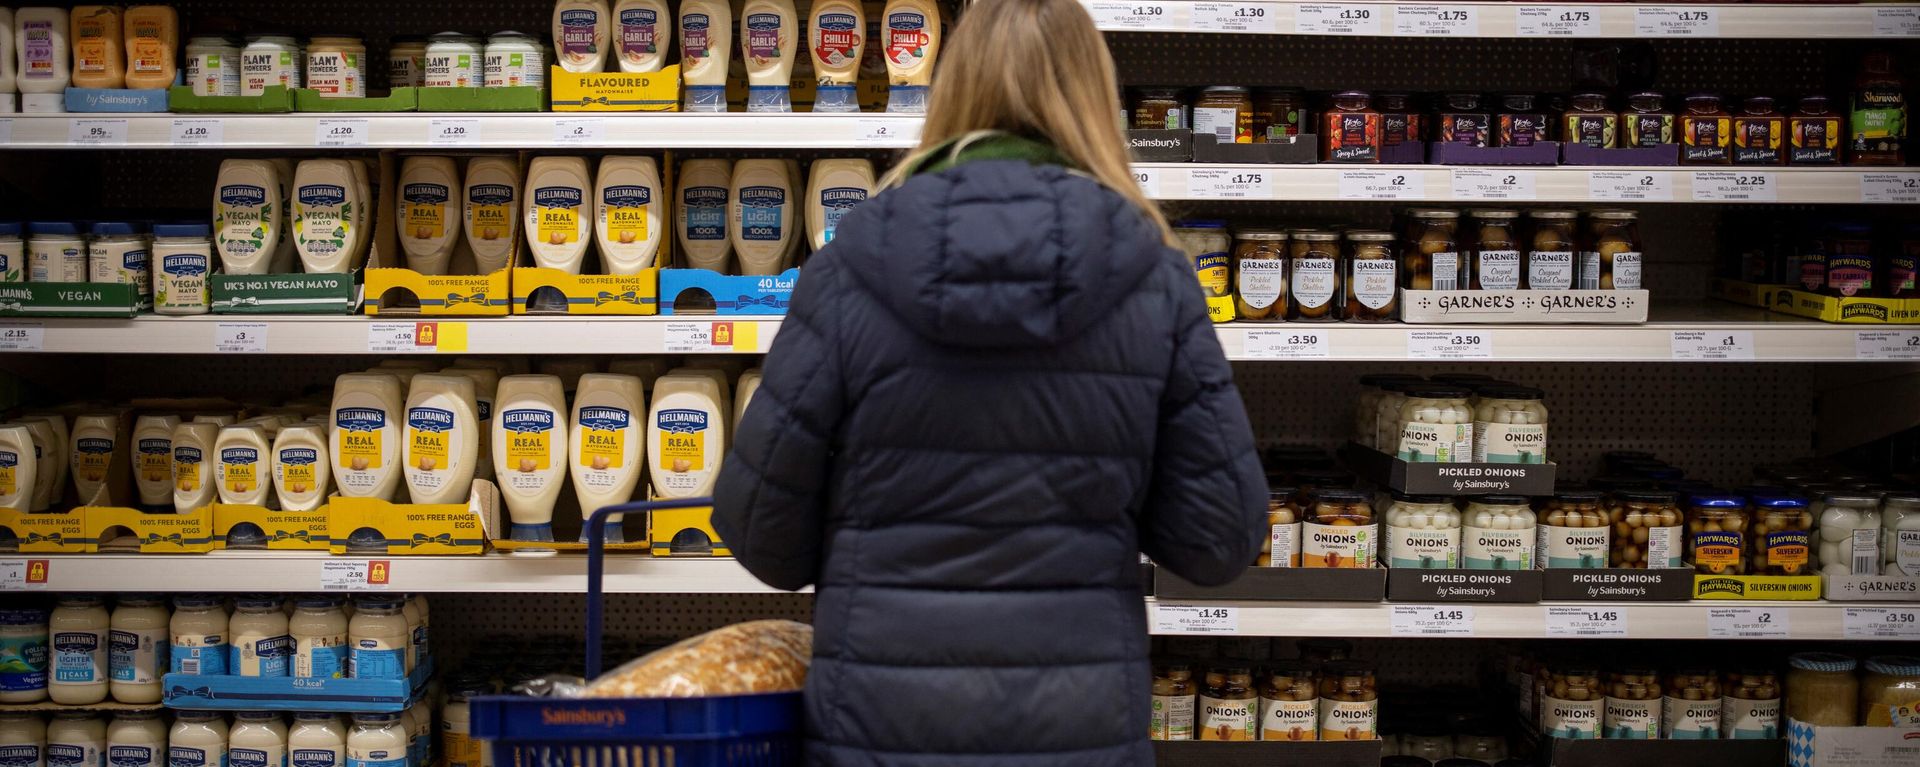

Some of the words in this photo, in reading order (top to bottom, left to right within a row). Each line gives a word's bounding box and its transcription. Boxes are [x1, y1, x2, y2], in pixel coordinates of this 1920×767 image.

[562, 11, 596, 20] HELLMANN'S
[621, 11, 655, 20] HELLMANN'S
[1133, 7, 1163, 16] £1.30
[1235, 8, 1264, 17] £1.30
[1340, 9, 1370, 19] £1.30
[1438, 11, 1468, 21] £1.75
[1560, 12, 1590, 21] £1.75
[1679, 11, 1708, 21] £1.75
[748, 16, 779, 24] HELLMANN'S
[821, 15, 854, 24] HELLMANN'S
[890, 15, 922, 24] HELLMANN'S
[565, 33, 593, 42] GARLIC
[625, 33, 652, 42] GARLIC
[751, 37, 777, 47] GARLIC
[824, 34, 850, 44] CHILLI
[893, 34, 917, 43] CHILLI
[243, 55, 272, 65] PLANT
[310, 56, 338, 66] PLANT
[580, 78, 649, 87] FLAVOURED
[86, 94, 98, 105] by
[98, 94, 148, 106] Sainsbury's
[90, 127, 106, 136] 95p
[185, 127, 206, 135] £1.20
[331, 127, 352, 135] £1.20
[574, 127, 583, 135] £2
[1131, 138, 1180, 148] Sainsbury's
[1336, 149, 1350, 158] Spicy
[1355, 148, 1370, 156] Sweet
[1688, 150, 1702, 159] Sweet
[1707, 148, 1723, 157] Spiced
[1232, 174, 1261, 184] £1.75
[1392, 175, 1406, 185] £2
[1640, 176, 1653, 185] £2
[1736, 176, 1765, 185] £2.25
[222, 188, 263, 199] HELLMANN'S
[300, 187, 342, 199] HELLMANN'S
[406, 186, 446, 197] HELLMANN'S
[471, 187, 511, 198] HELLMANN'S
[537, 189, 579, 201] HELLMANN'S
[606, 188, 648, 199] HELLMANN'S
[742, 189, 782, 200] HELLMANN'S
[225, 211, 259, 220] VEGAN
[304, 211, 339, 220] VEGAN
[413, 208, 437, 217] REAL
[545, 213, 571, 222] REAL
[614, 212, 640, 220] REAL
[747, 212, 776, 222] LIGHT
[750, 227, 773, 235] 100%
[165, 255, 207, 268] HELLMANN'S
[1482, 253, 1519, 263] GARNER'S
[1242, 261, 1279, 271] GARNER'S
[1294, 260, 1332, 271] GARNER'S
[1357, 261, 1394, 271] GARNER'S
[1491, 268, 1513, 277] Original
[171, 280, 203, 288] VEGAN
[224, 281, 244, 290] UK'S
[247, 281, 267, 290] NO.1
[270, 280, 300, 289] VEGAN
[303, 279, 338, 288] MAYO
[758, 278, 772, 288] 40
[775, 278, 794, 288] kcal
[58, 291, 101, 301] VEGAN
[1438, 295, 1515, 314] GARNER'S
[1541, 295, 1617, 314] GARNER'S
[1844, 307, 1886, 319] HAYWARDS
[1891, 310, 1908, 318] LIVEN
[4, 330, 26, 338] £2.15
[236, 332, 246, 340] £3
[1288, 335, 1317, 344] £3.50
[1451, 335, 1480, 345] £3.50
[1723, 335, 1735, 346] £1
[338, 410, 382, 422] HELLMANN'S
[410, 411, 451, 423] HELLMANN'S
[505, 412, 551, 424] HELLMANN'S
[582, 411, 626, 422] HELLMANN'S
[660, 412, 705, 424] HELLMANN'S
[346, 436, 373, 445] REAL
[589, 435, 616, 445] REAL
[1402, 430, 1438, 441] ONIONS
[1505, 433, 1543, 442] ONIONS
[416, 436, 442, 446] REAL
[514, 438, 543, 447] REAL
[668, 438, 696, 447] REAL
[222, 450, 256, 459] HELLMANN'S
[281, 450, 315, 459] HELLMANN'S
[1439, 468, 1481, 477] PICKLED
[1485, 468, 1525, 477] ONIONS
[1452, 479, 1464, 489] by
[1464, 478, 1510, 489] Sainsbury's
[1314, 533, 1356, 544] ONIONS
[1406, 538, 1449, 547] ONIONS
[1479, 538, 1521, 547] ONIONS
[1697, 535, 1739, 545] HAYWARDS
[1422, 574, 1466, 583] PICKLED
[1469, 575, 1511, 584] ONIONS
[1573, 574, 1617, 583] PICKLED
[1620, 575, 1661, 583] ONIONS
[1437, 586, 1447, 595] by
[1448, 586, 1495, 595] Sainsbury's
[1599, 586, 1646, 596] Sainsbury's
[1750, 583, 1786, 591] SILVERSKIN
[1788, 583, 1812, 591] ONIONS
[1859, 581, 1916, 595] GARNER'S
[1199, 609, 1228, 618] £1.45
[1434, 611, 1463, 620] £1.45
[1588, 612, 1617, 621] £1.45
[1758, 613, 1771, 623] £2
[1886, 613, 1914, 622] £3.50
[55, 635, 95, 645] HELLMANN'S
[292, 679, 304, 687] 40
[1206, 706, 1247, 716] ONIONS
[1275, 709, 1314, 718] ONIONS
[1333, 709, 1373, 718] ONIONS
[1608, 707, 1648, 717] ONIONS
[541, 707, 626, 728] Sainsbury's
[294, 750, 333, 761] HELLMANN'S
